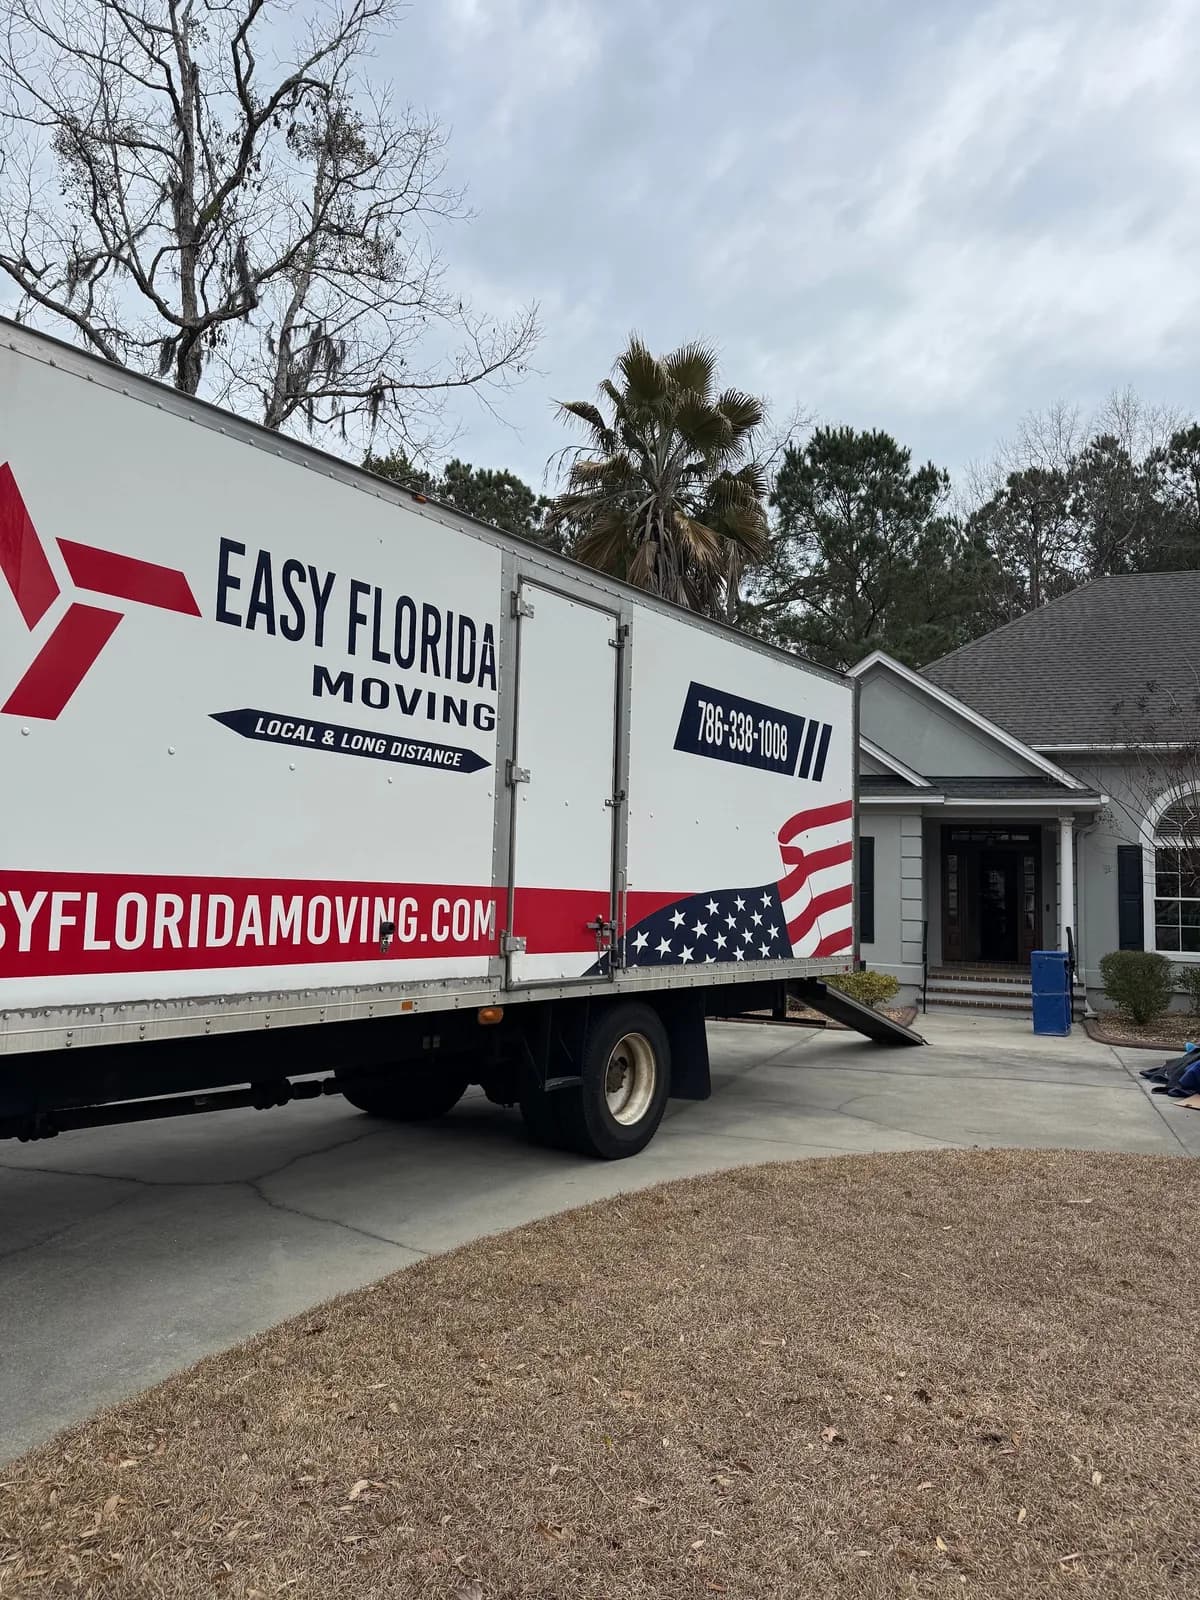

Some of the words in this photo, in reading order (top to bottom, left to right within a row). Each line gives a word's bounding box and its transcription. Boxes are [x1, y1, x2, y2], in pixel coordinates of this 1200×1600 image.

[216, 537, 336, 647] EASY
[348, 579, 496, 691] FLORIDA
[312, 664, 496, 731] MOVING
[255, 718, 315, 742] LOCAL
[321, 730, 335, 745] &
[341, 733, 386, 754] LONG
[390, 742, 463, 767] DISTANCE
[698, 700, 788, 762] 786-338-1008
[0, 890, 496, 952] YFLORIDAMOVING.COM
